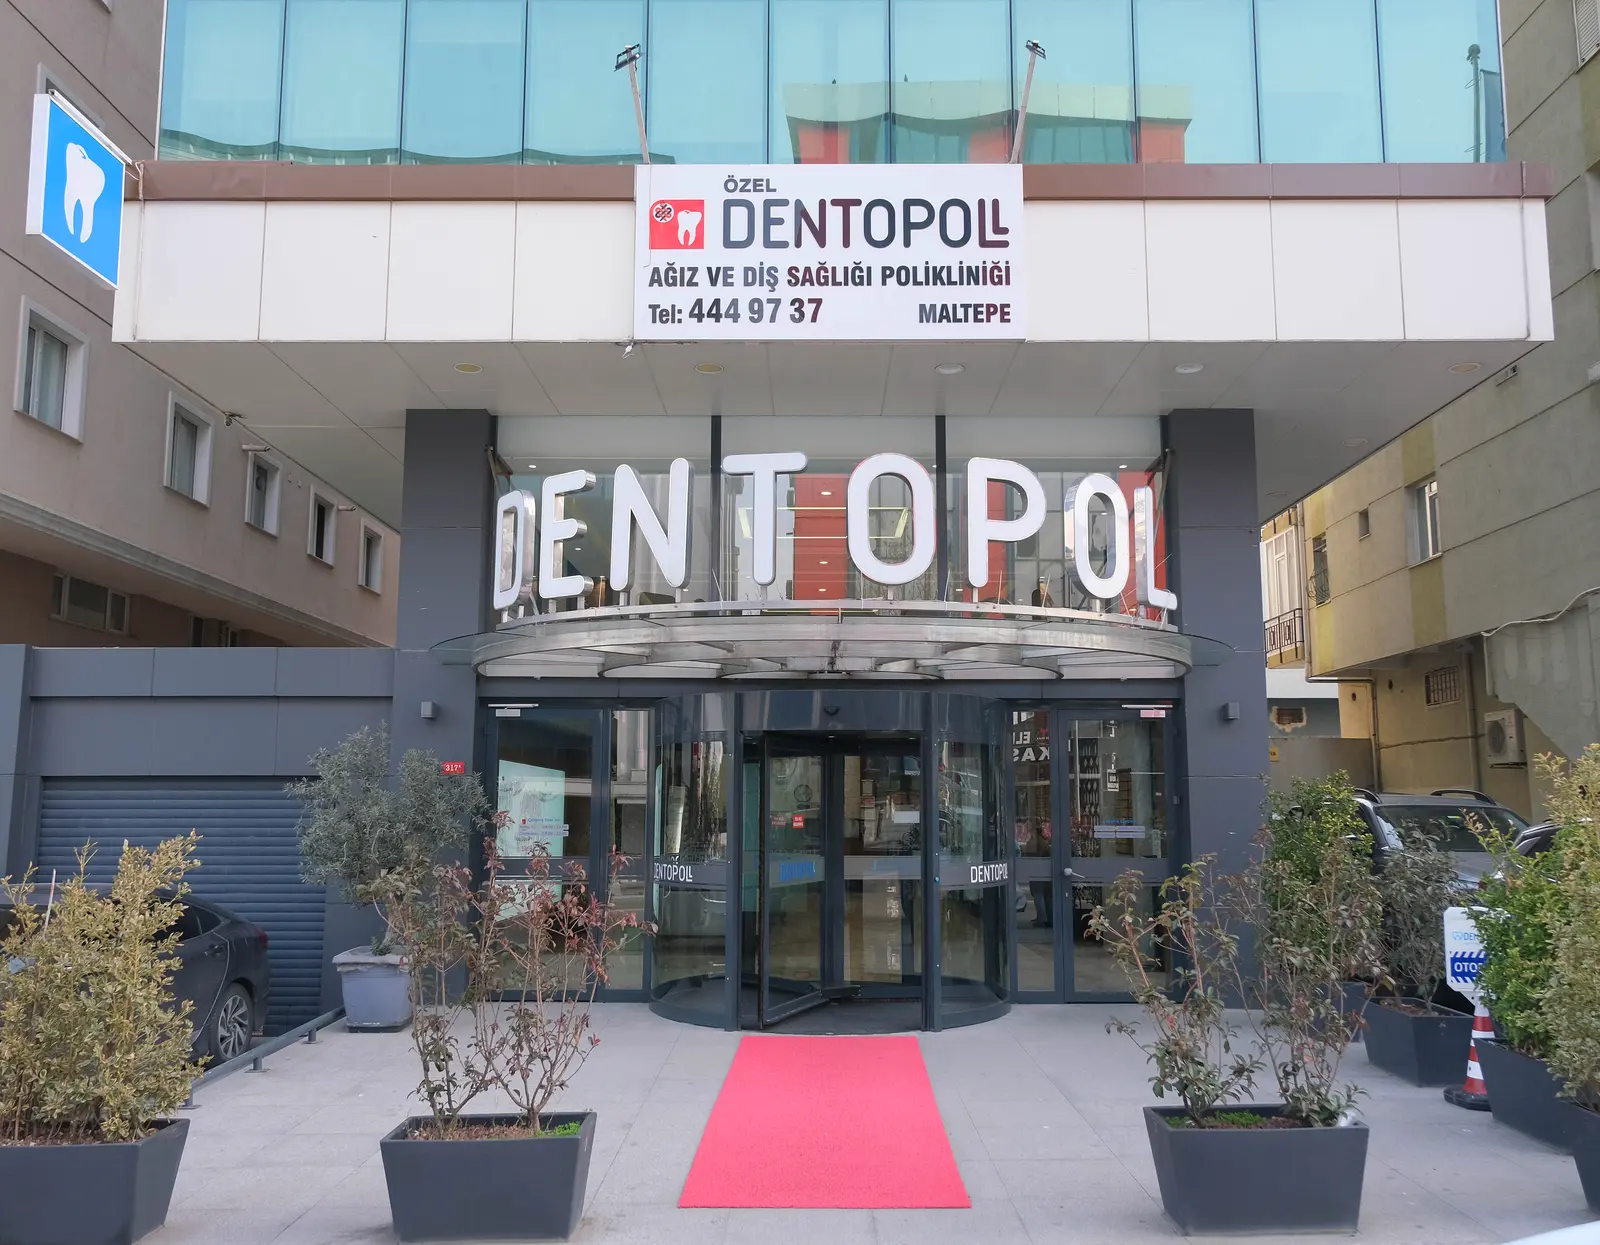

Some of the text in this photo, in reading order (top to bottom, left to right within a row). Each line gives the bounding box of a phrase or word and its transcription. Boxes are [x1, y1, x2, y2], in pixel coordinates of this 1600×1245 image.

[723, 175, 776, 193] ÖZEL
[648, 261, 1011, 292] AĞIZ VE DİŞ SAĞLIĞI POLİKLİNİĞİ
[648, 298, 1011, 324] Tel: 444 97 37 MALTEPE
[493, 451, 1179, 611] DENTOPOL
[1454, 961, 1483, 972] OTO
